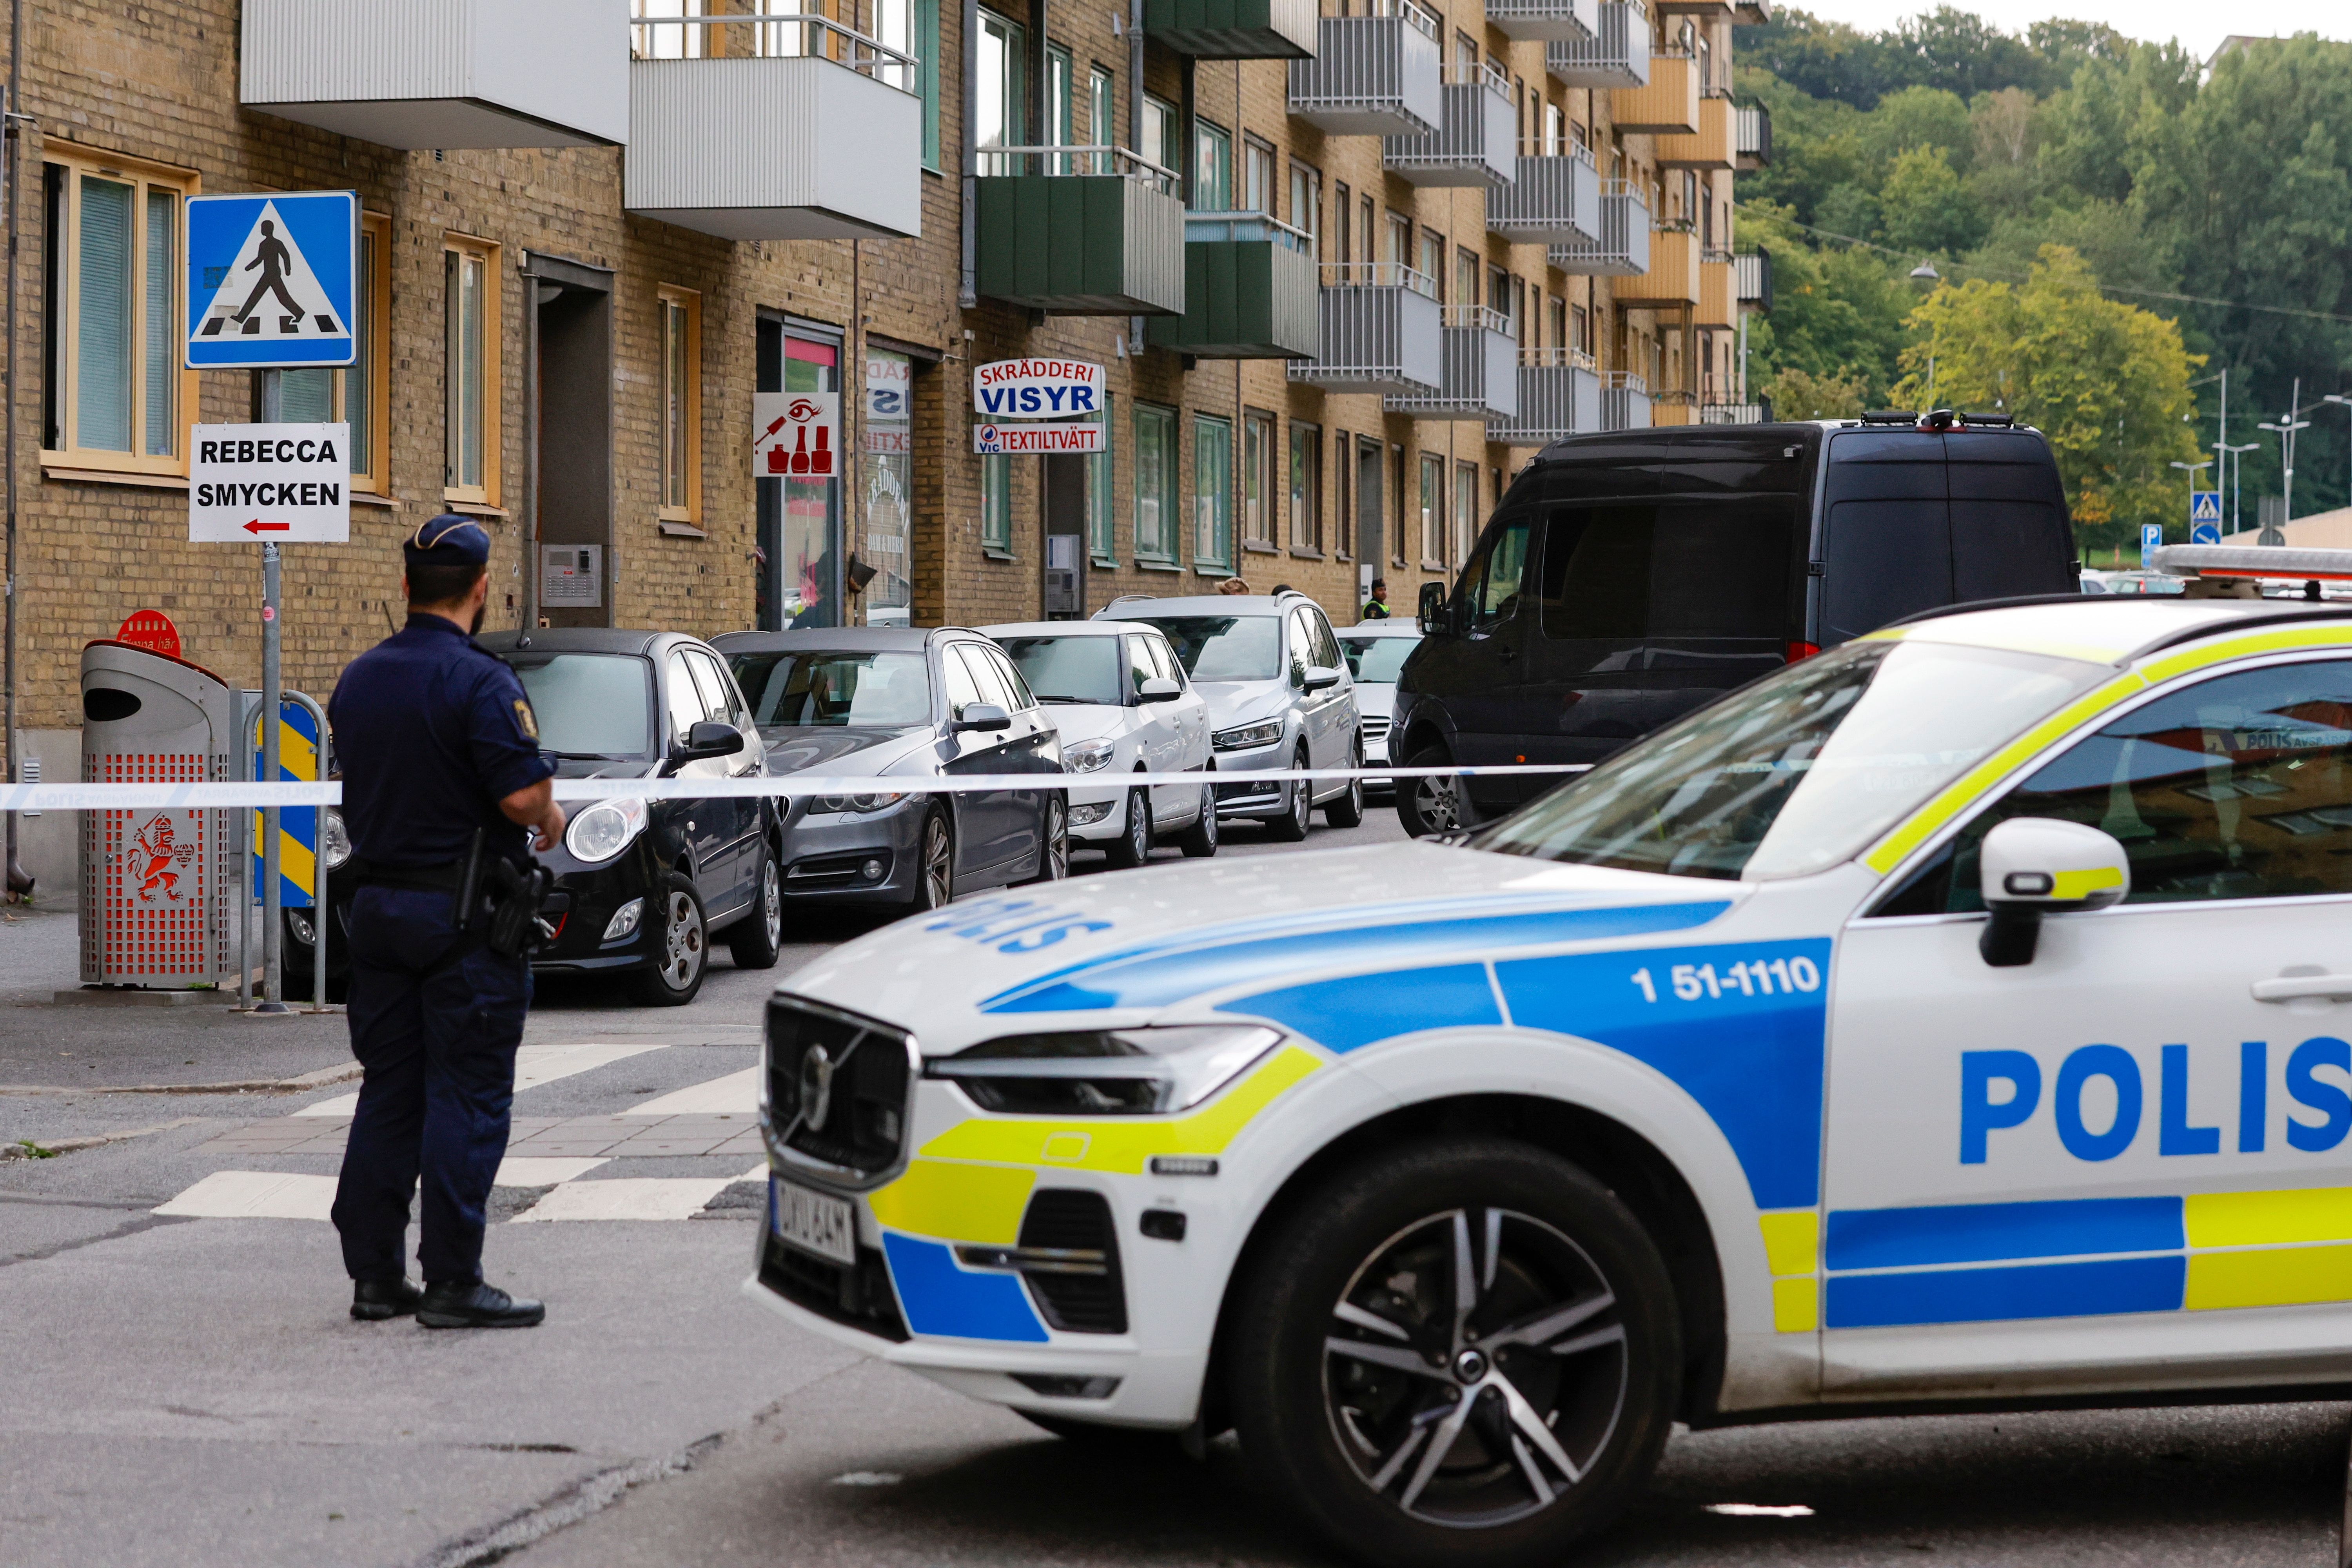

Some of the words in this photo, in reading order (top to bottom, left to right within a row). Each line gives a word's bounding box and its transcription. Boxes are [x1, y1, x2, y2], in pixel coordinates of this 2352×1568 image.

[981, 359, 1094, 385] SKRÄDDERI
[980, 386, 1094, 413] VISYR
[1000, 426, 1097, 450] TEXTILTVÄTT
[201, 440, 338, 463] REBECCA
[198, 483, 339, 506] SMYCKEN
[2147, 527, 2159, 544] P
[158, 636, 176, 649] här
[1631, 967, 1657, 1003] 1
[1671, 956, 1820, 1001] 51-1110
[1960, 1036, 2352, 1164] POLIS
